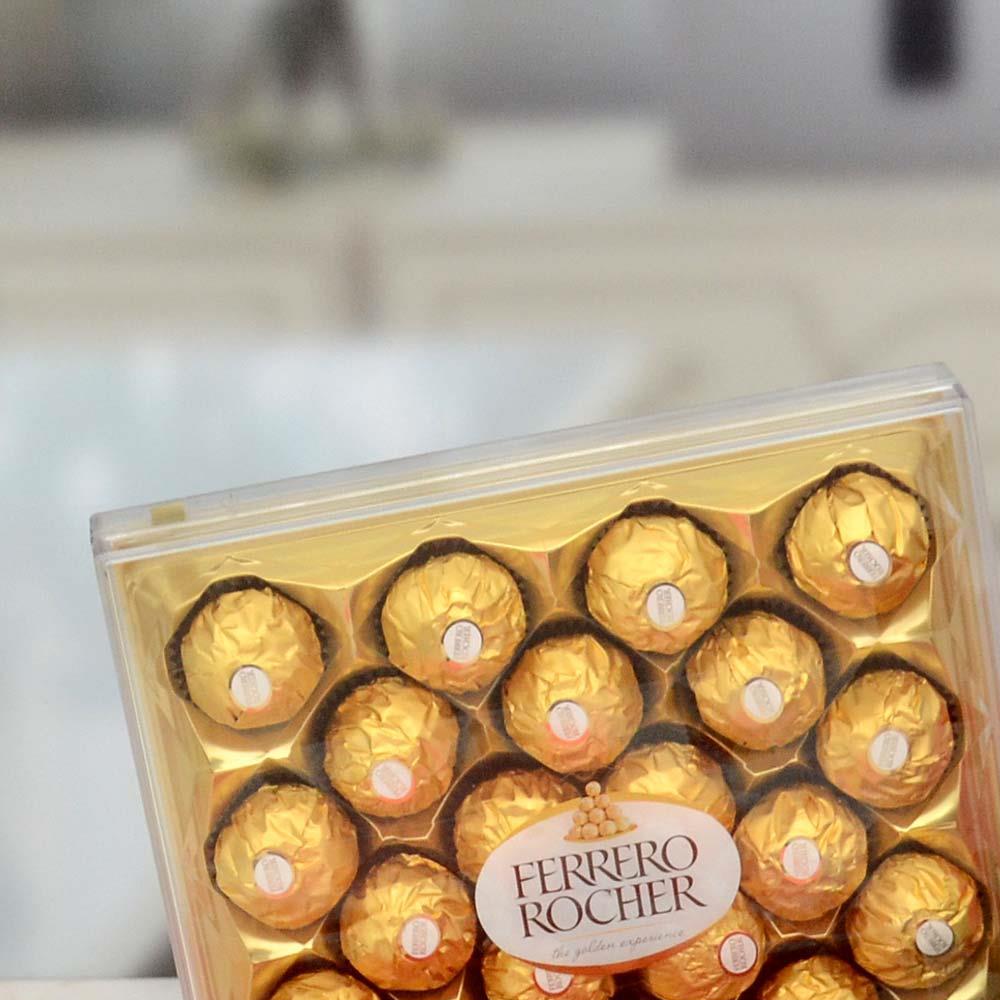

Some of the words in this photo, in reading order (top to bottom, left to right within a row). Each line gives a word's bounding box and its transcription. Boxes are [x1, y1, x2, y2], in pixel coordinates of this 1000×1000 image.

[511, 834, 699, 899] FERRERO
[518, 874, 707, 939] ROCHER
[551, 944, 569, 960] the
[572, 937, 616, 962] golden
[619, 929, 685, 953] experience
